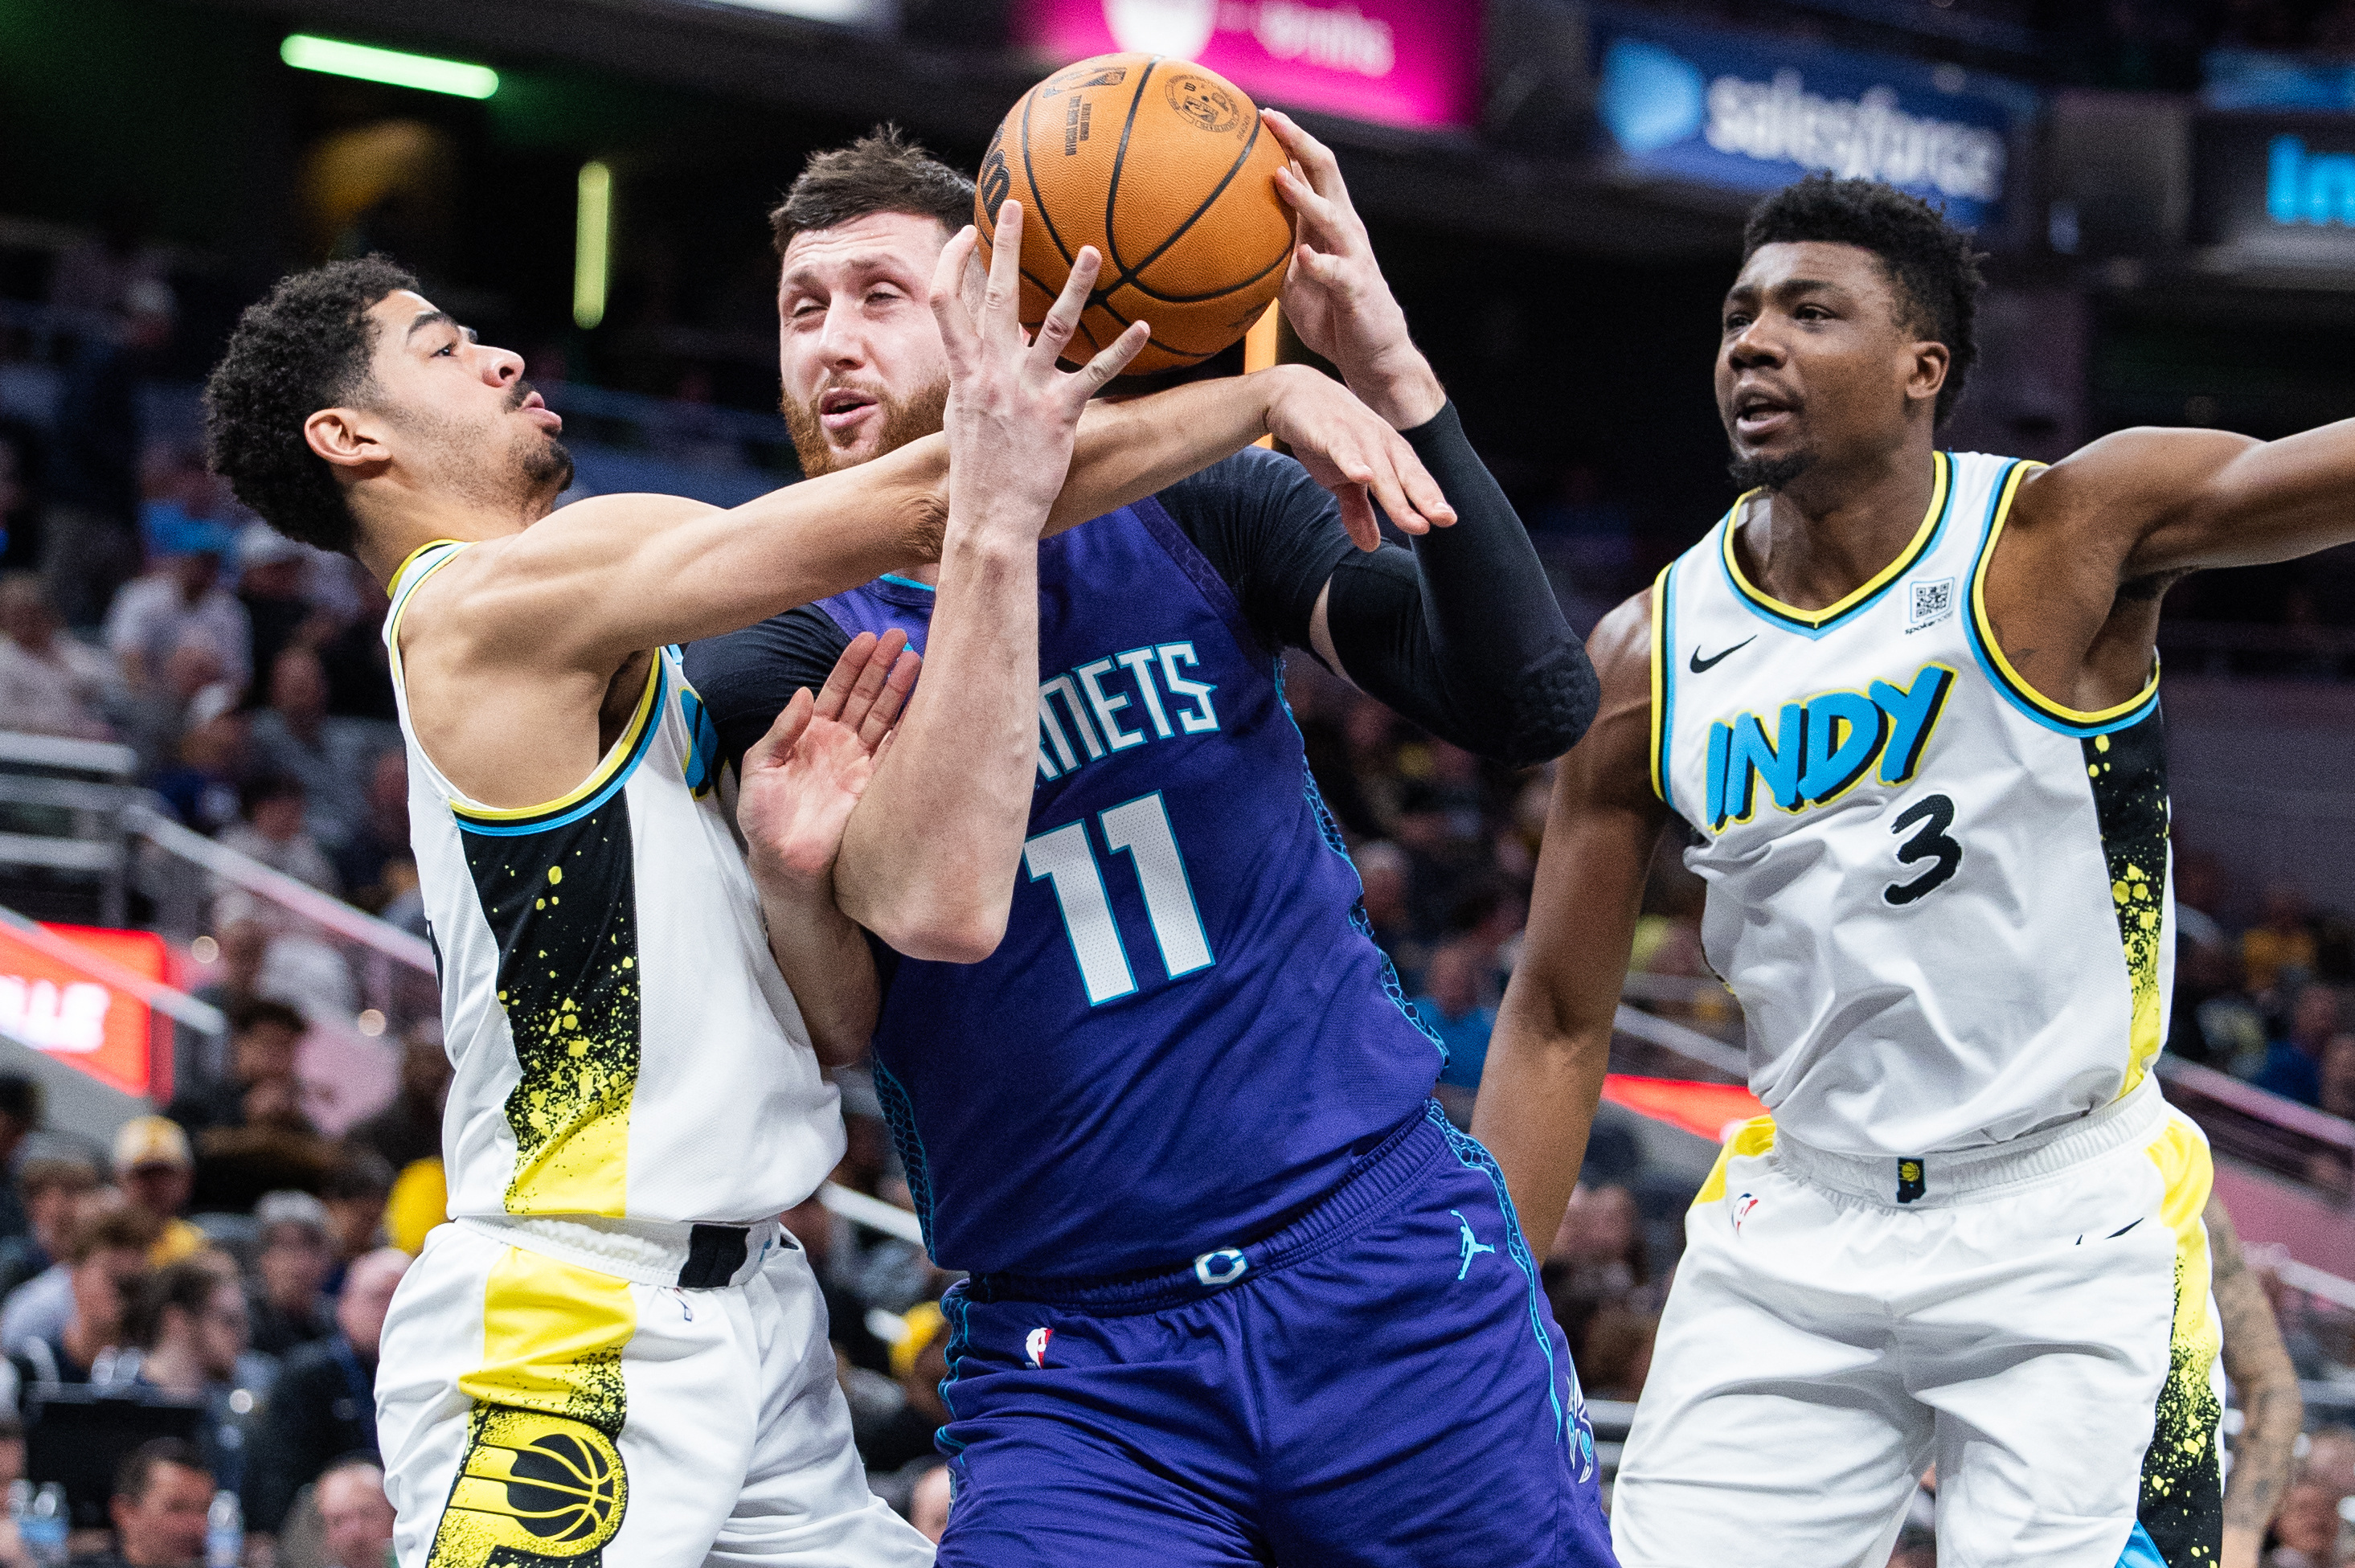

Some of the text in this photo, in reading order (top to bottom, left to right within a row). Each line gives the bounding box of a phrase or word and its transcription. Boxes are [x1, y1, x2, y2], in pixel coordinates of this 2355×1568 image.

[1038, 641, 1220, 781] NETS
[1704, 661, 1959, 835] INDY
[1022, 789, 1216, 1006] 11
[1881, 793, 1963, 907] 3
